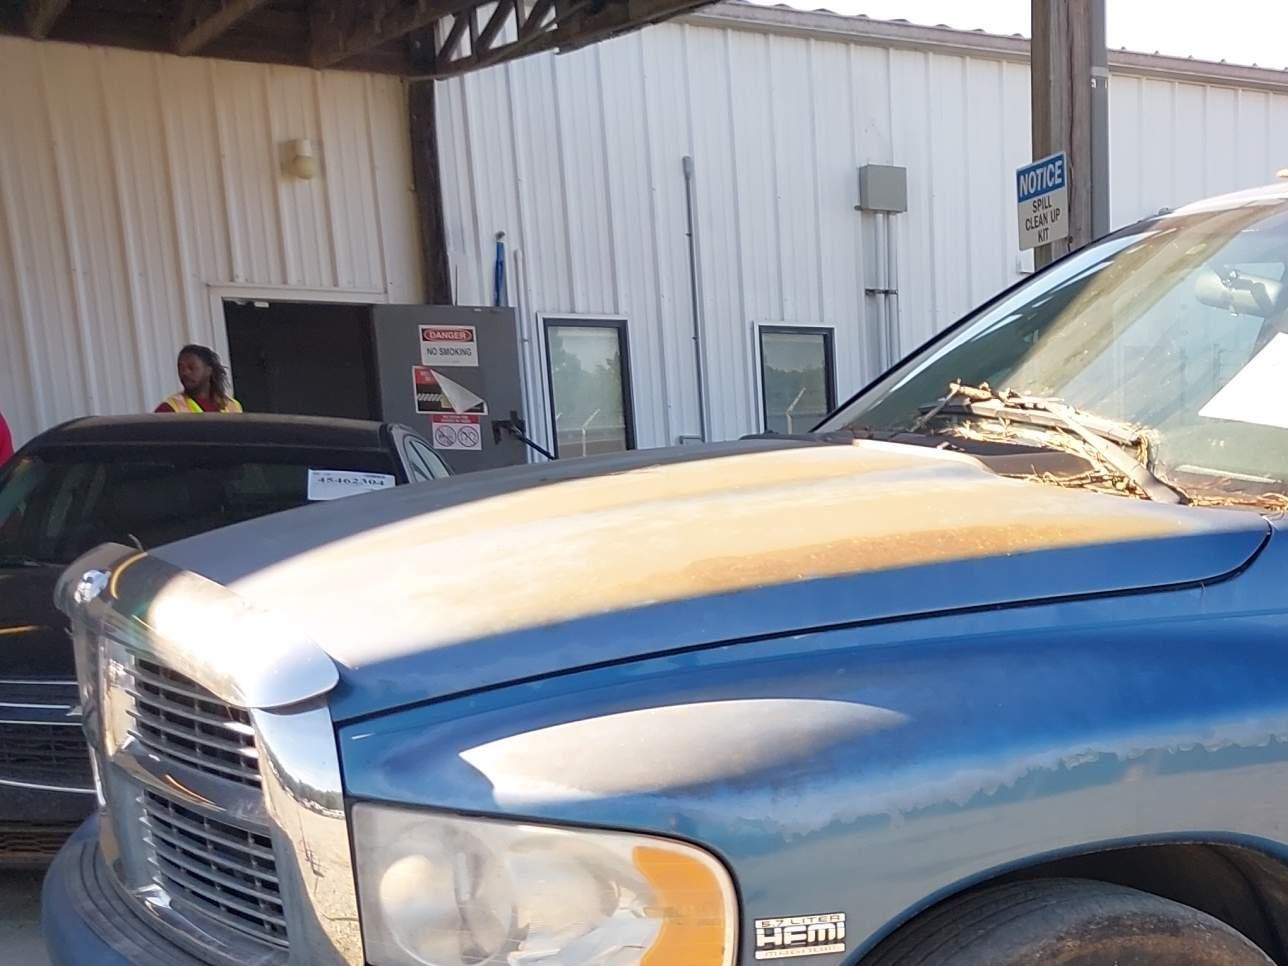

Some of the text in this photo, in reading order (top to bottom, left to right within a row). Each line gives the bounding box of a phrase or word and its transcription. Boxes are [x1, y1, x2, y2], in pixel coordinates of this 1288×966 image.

[1019, 159, 1063, 197] NOTICE
[1032, 195, 1052, 213] SPILL
[1025, 208, 1061, 231] CLEAN UP
[1038, 227, 1049, 243] KIT
[429, 330, 467, 340] DANGER
[426, 347, 472, 356] NO SMOKING
[790, 914, 841, 924] LITER
[756, 921, 846, 947] HEMI
